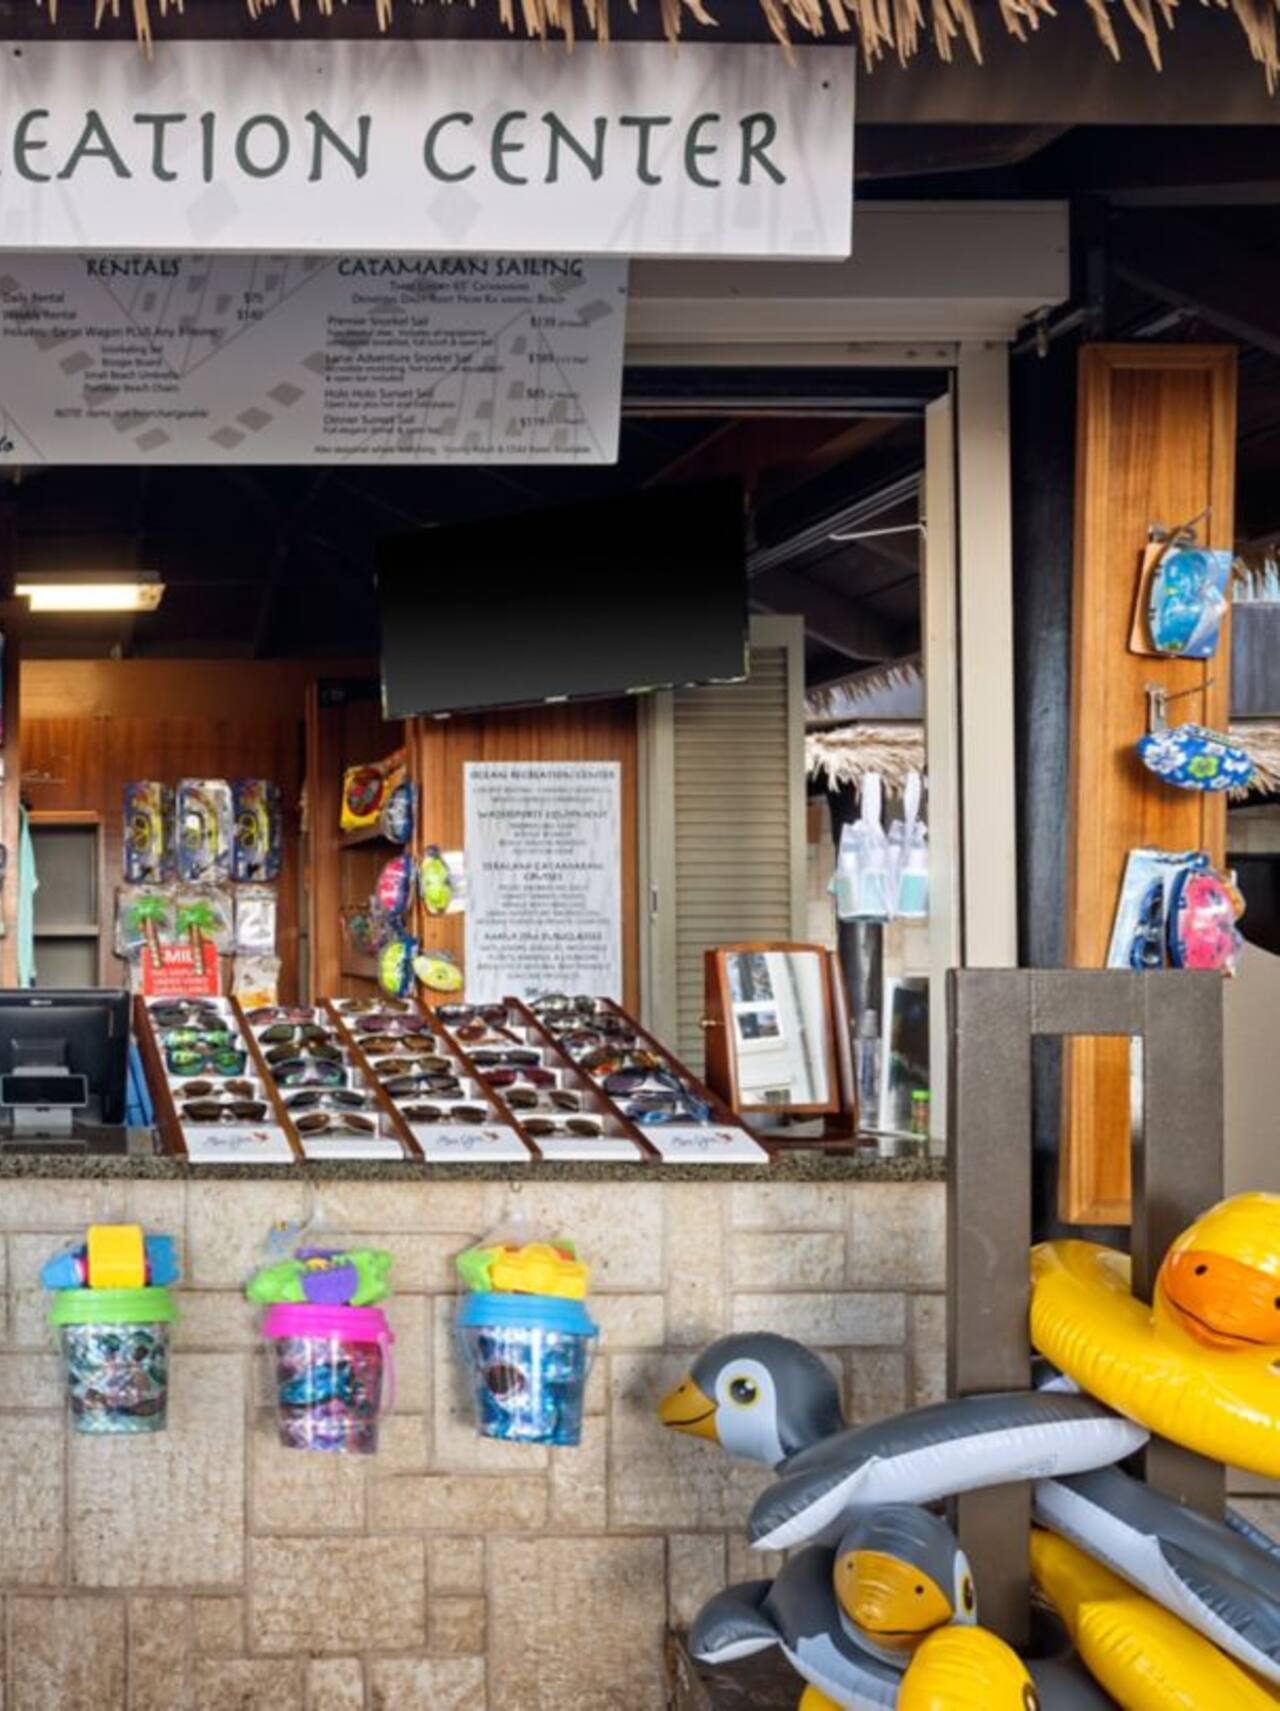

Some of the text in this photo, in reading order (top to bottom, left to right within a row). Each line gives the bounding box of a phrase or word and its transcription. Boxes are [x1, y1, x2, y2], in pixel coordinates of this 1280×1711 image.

[424, 110, 786, 188] CENTER
[86, 258, 179, 277] RENTALS
[337, 257, 583, 277] CATAMARAN SAILING
